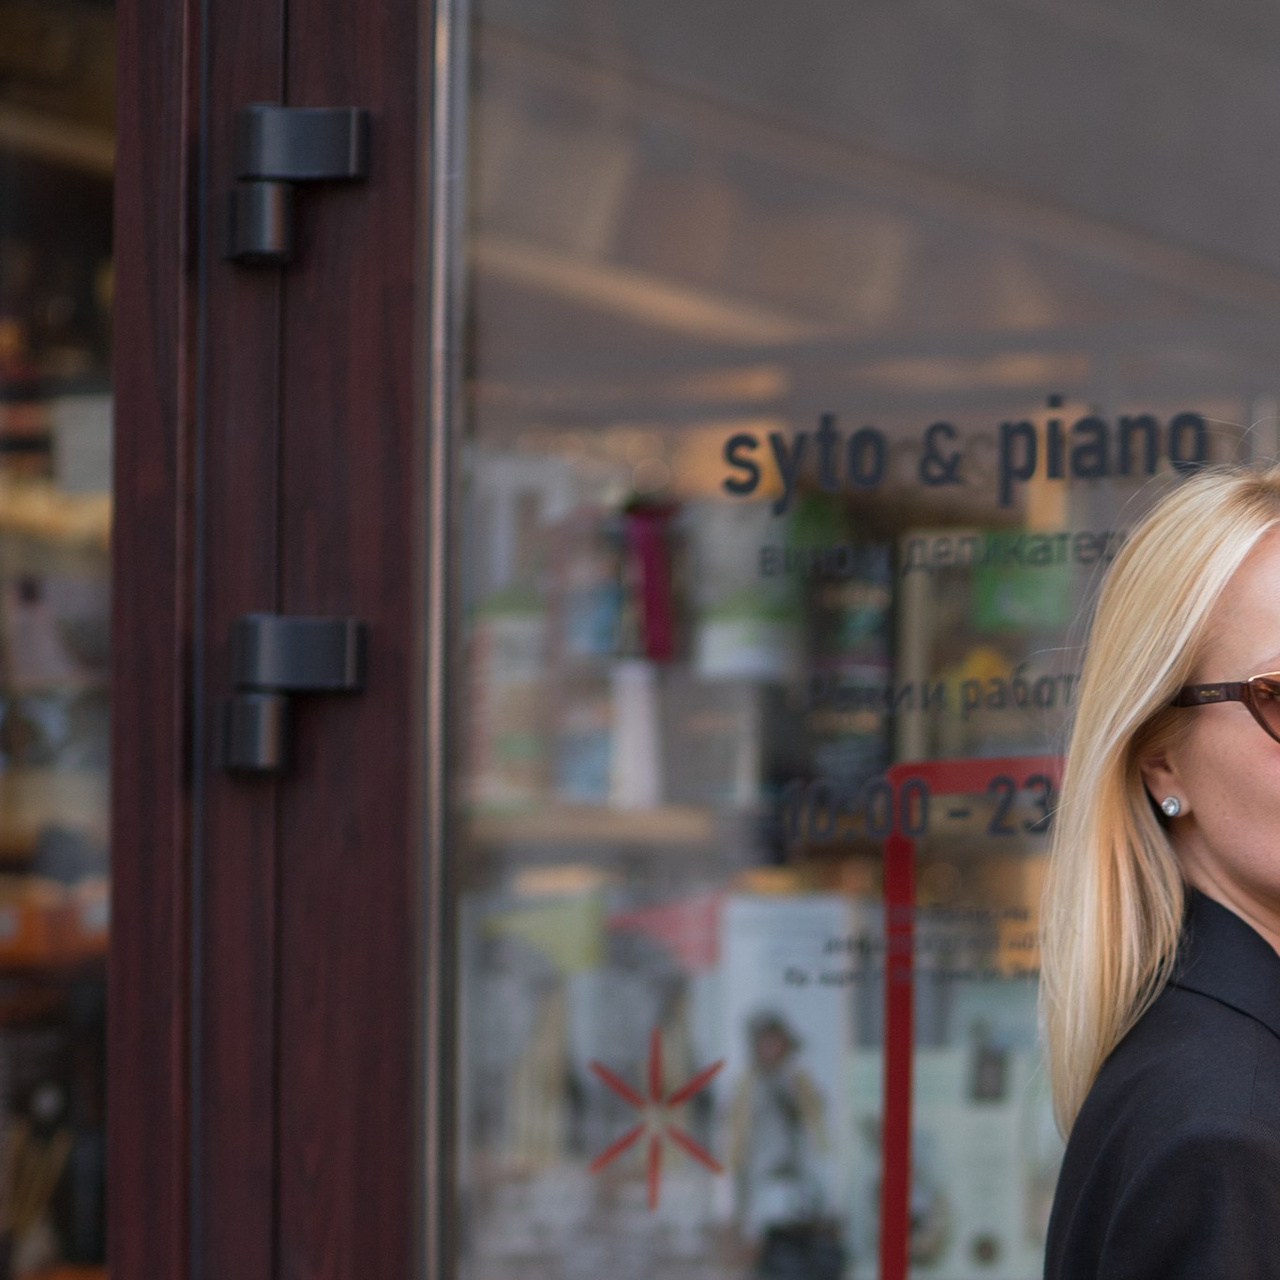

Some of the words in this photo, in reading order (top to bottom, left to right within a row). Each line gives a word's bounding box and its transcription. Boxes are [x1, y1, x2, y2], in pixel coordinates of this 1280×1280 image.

[723, 413, 885, 516] syto
[920, 421, 966, 487] &
[998, 393, 1208, 508] piano
[961, 660, 1081, 721] работ
